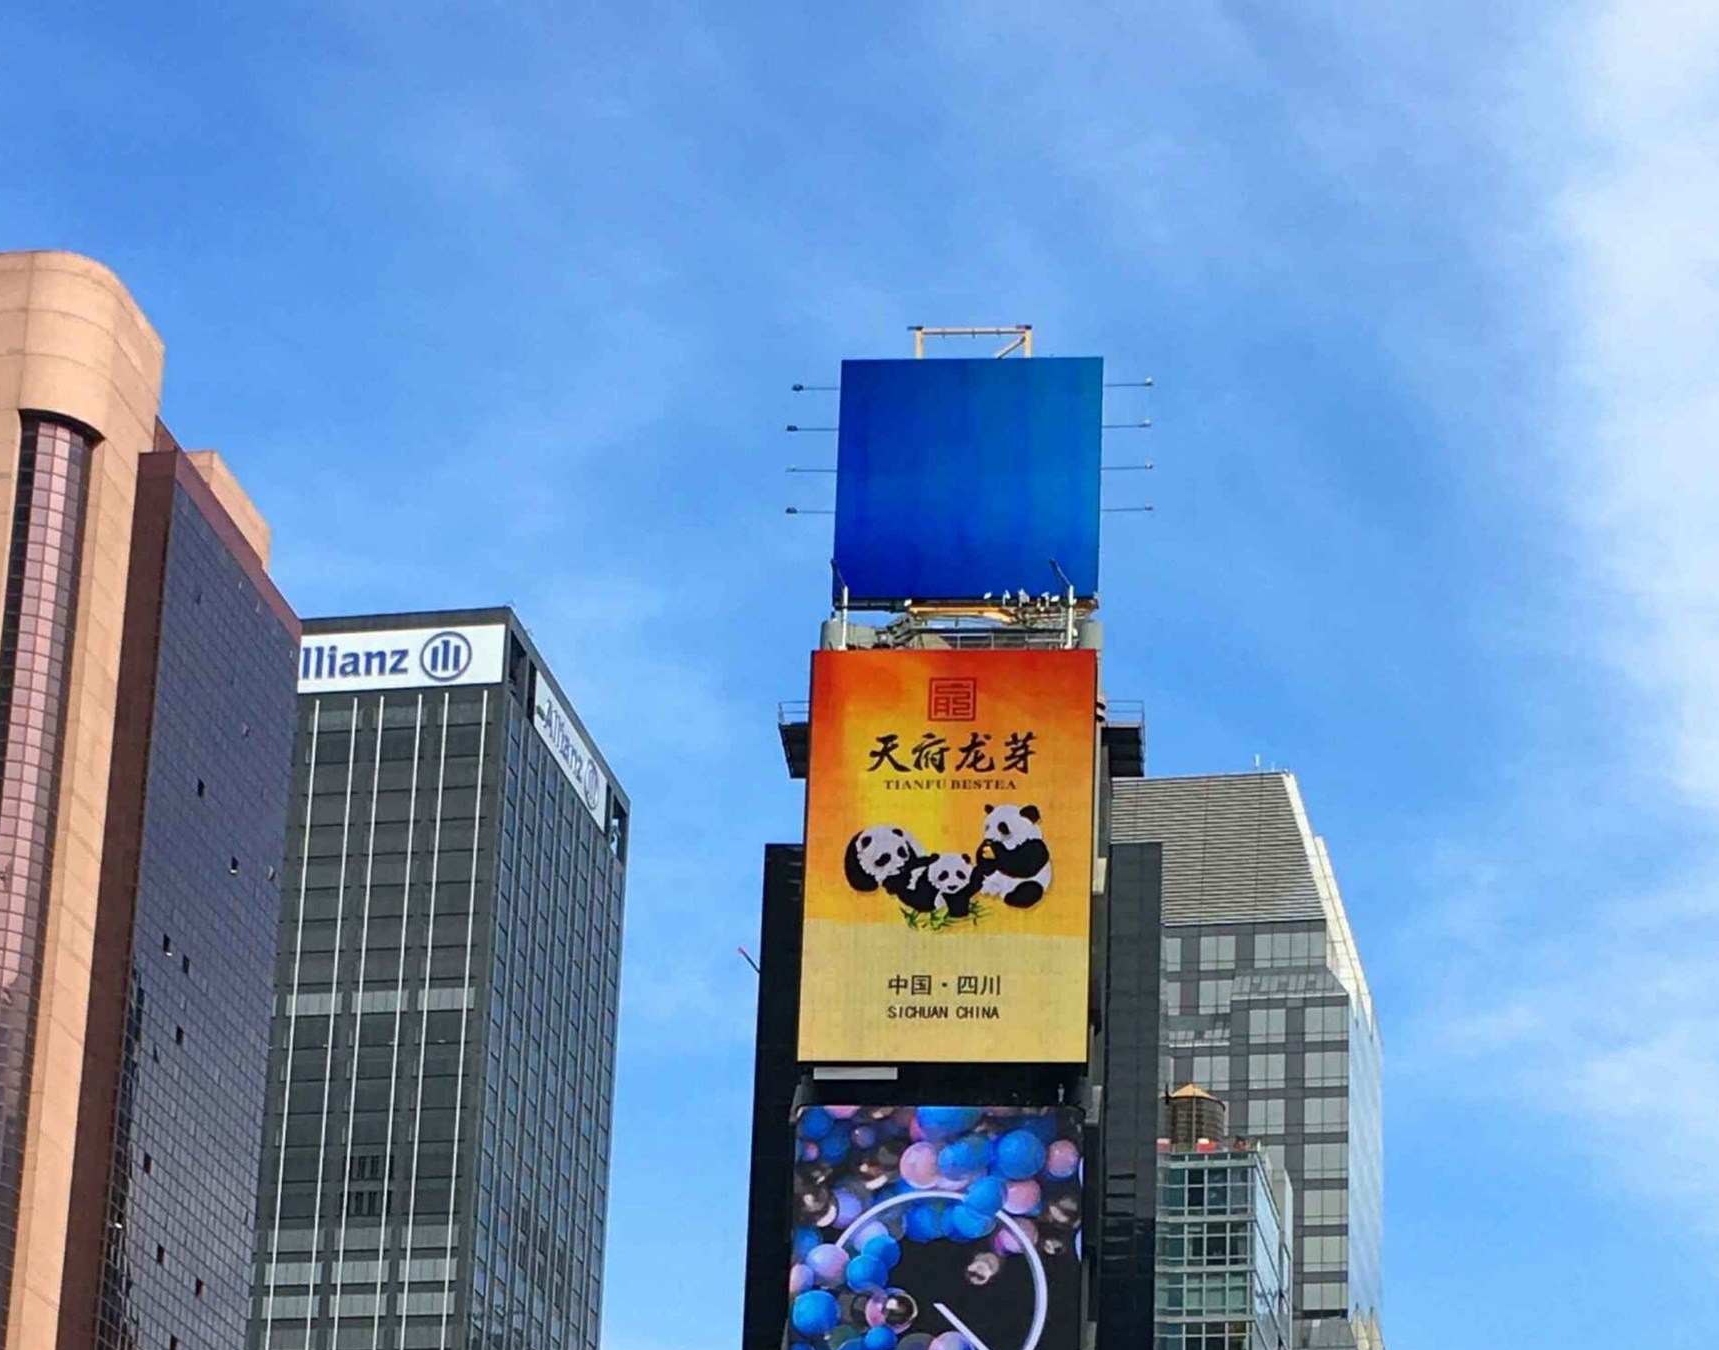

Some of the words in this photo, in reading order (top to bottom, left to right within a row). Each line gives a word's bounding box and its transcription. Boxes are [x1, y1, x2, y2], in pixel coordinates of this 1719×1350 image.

[301, 645, 409, 681] llianz
[884, 779, 948, 790] TIANFU
[950, 779, 1018, 791] BESTEA
[887, 1005, 949, 1019] SICHUAN
[955, 1005, 1000, 1020] CHINA
